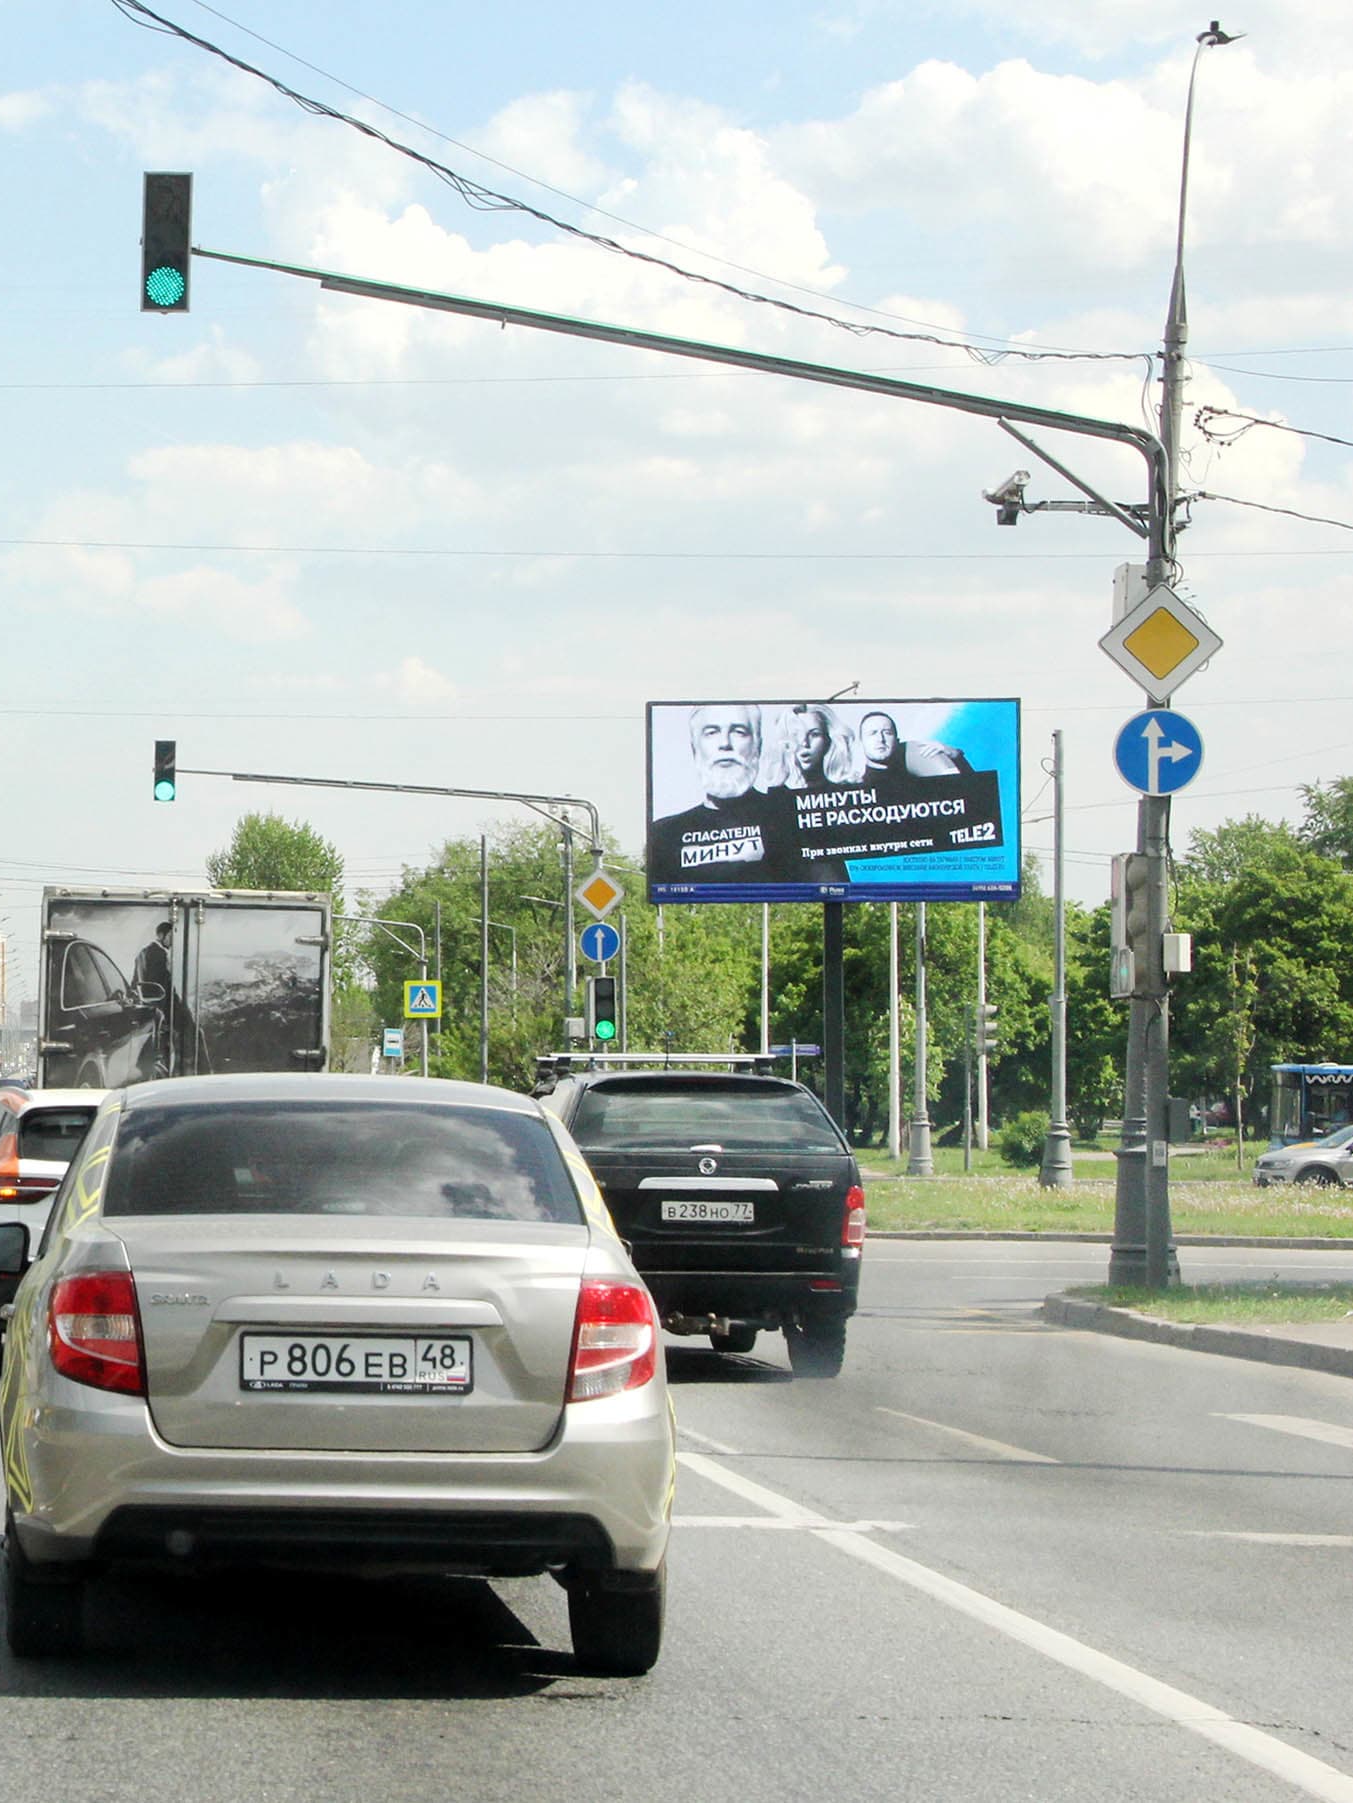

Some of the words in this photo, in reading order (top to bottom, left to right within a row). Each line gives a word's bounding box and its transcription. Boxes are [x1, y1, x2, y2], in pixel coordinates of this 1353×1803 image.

[796, 788, 877, 811] МИНУТЫ
[797, 812, 823, 829] НЕ
[826, 799, 966, 827] РАСХОДУЮТСЯ
[681, 825, 761, 843] СПАСАТЕЛИ
[949, 822, 996, 844] TELE2
[683, 839, 760, 865] МИНУТ
[801, 846, 824, 859] При
[826, 843, 868, 856] звонках
[869, 841, 908, 853] внутри
[909, 839, 934, 848] сети
[272, 1271, 441, 1291] LADA
[421, 1343, 456, 1370] 48
[418, 1370, 446, 1381] RUS
